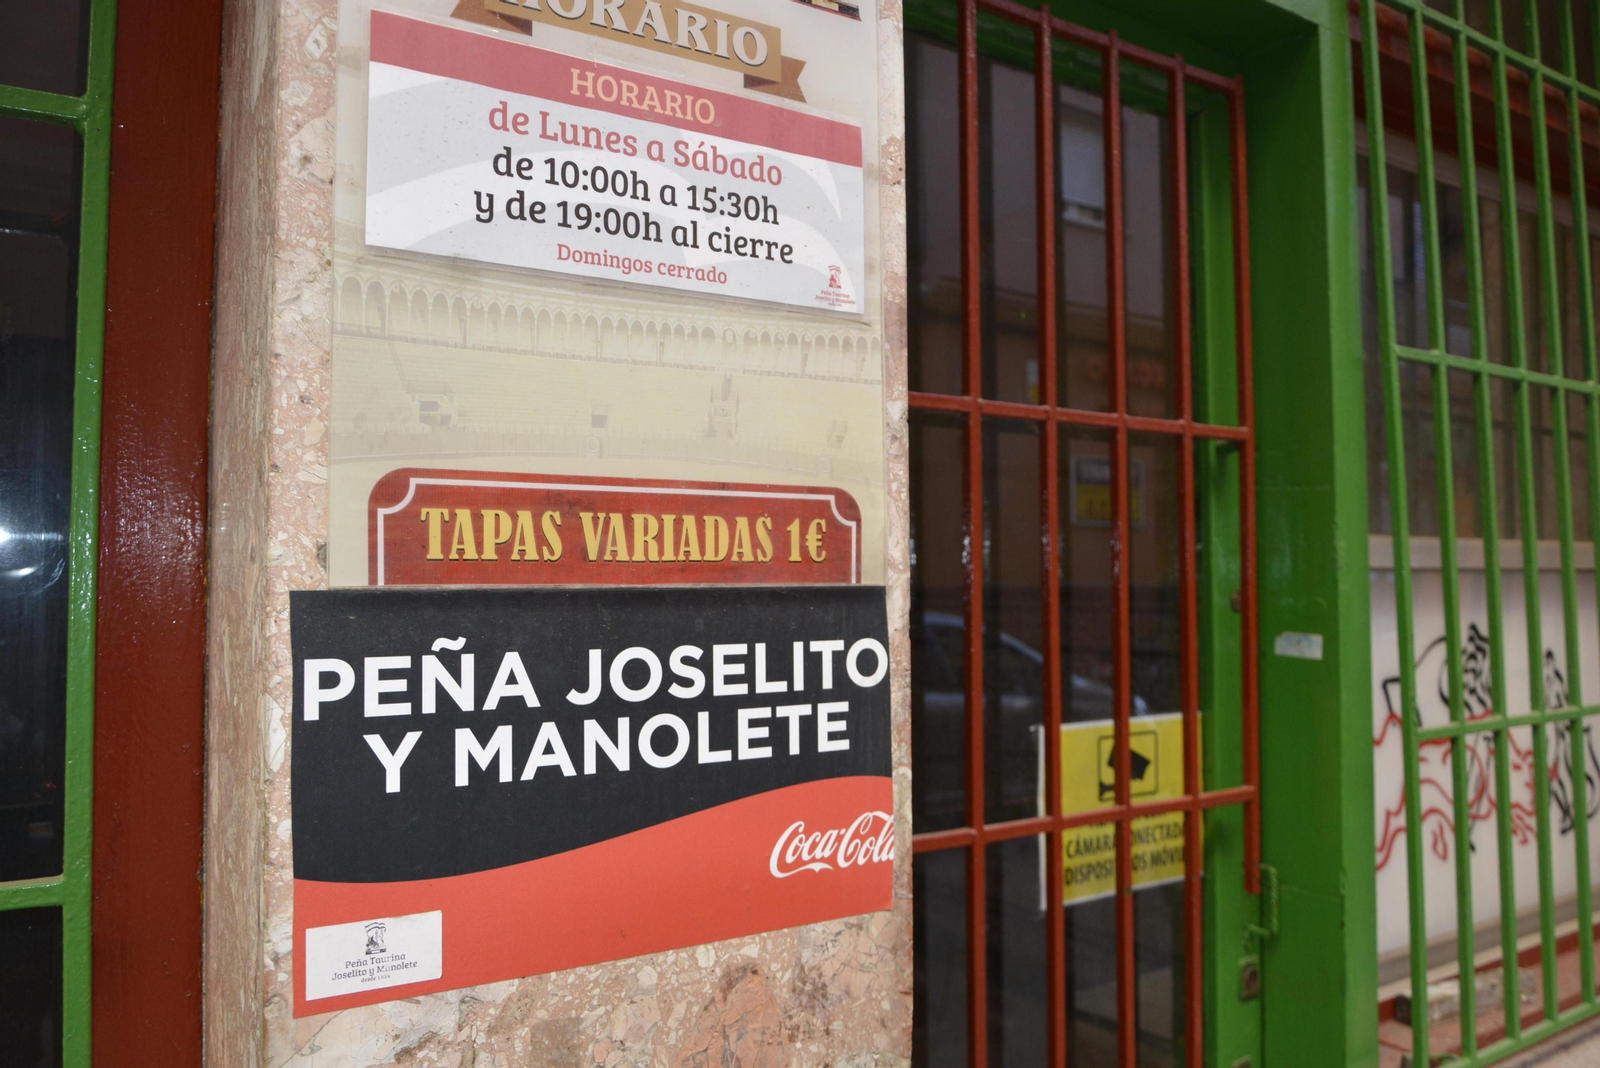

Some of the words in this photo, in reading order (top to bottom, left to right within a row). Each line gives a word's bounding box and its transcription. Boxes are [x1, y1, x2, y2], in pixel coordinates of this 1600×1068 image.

[497, 0, 768, 67] RARIO
[570, 68, 716, 125] HORARIO
[488, 100, 530, 136] de
[538, 110, 638, 158] Lunes
[646, 139, 665, 163] a
[673, 139, 783, 186] Sábado
[493, 146, 534, 181] de
[544, 157, 650, 202] 10:00h
[659, 183, 678, 207] a
[686, 184, 780, 226] 15:30h
[474, 190, 495, 224] y
[505, 189, 547, 224] de
[556, 200, 663, 244] 19:00h
[671, 220, 700, 250] al
[707, 226, 795, 265] cierre
[556, 243, 653, 275] Domingos
[657, 258, 728, 285] cerrado
[420, 507, 564, 564] TAPAS
[579, 511, 774, 564] VARIADAS
[786, 517, 828, 564] 1€
[303, 635, 541, 722] PEÑA
[566, 637, 889, 707] JOSELITO
[362, 731, 424, 794] Y
[454, 701, 851, 788] MANOLETE
[332, 968, 368, 981] Joselito
[369, 968, 375, 977] y
[376, 961, 418, 974] Manolete
[345, 959, 368, 969] Peña
[369, 953, 406, 966] Taurina
